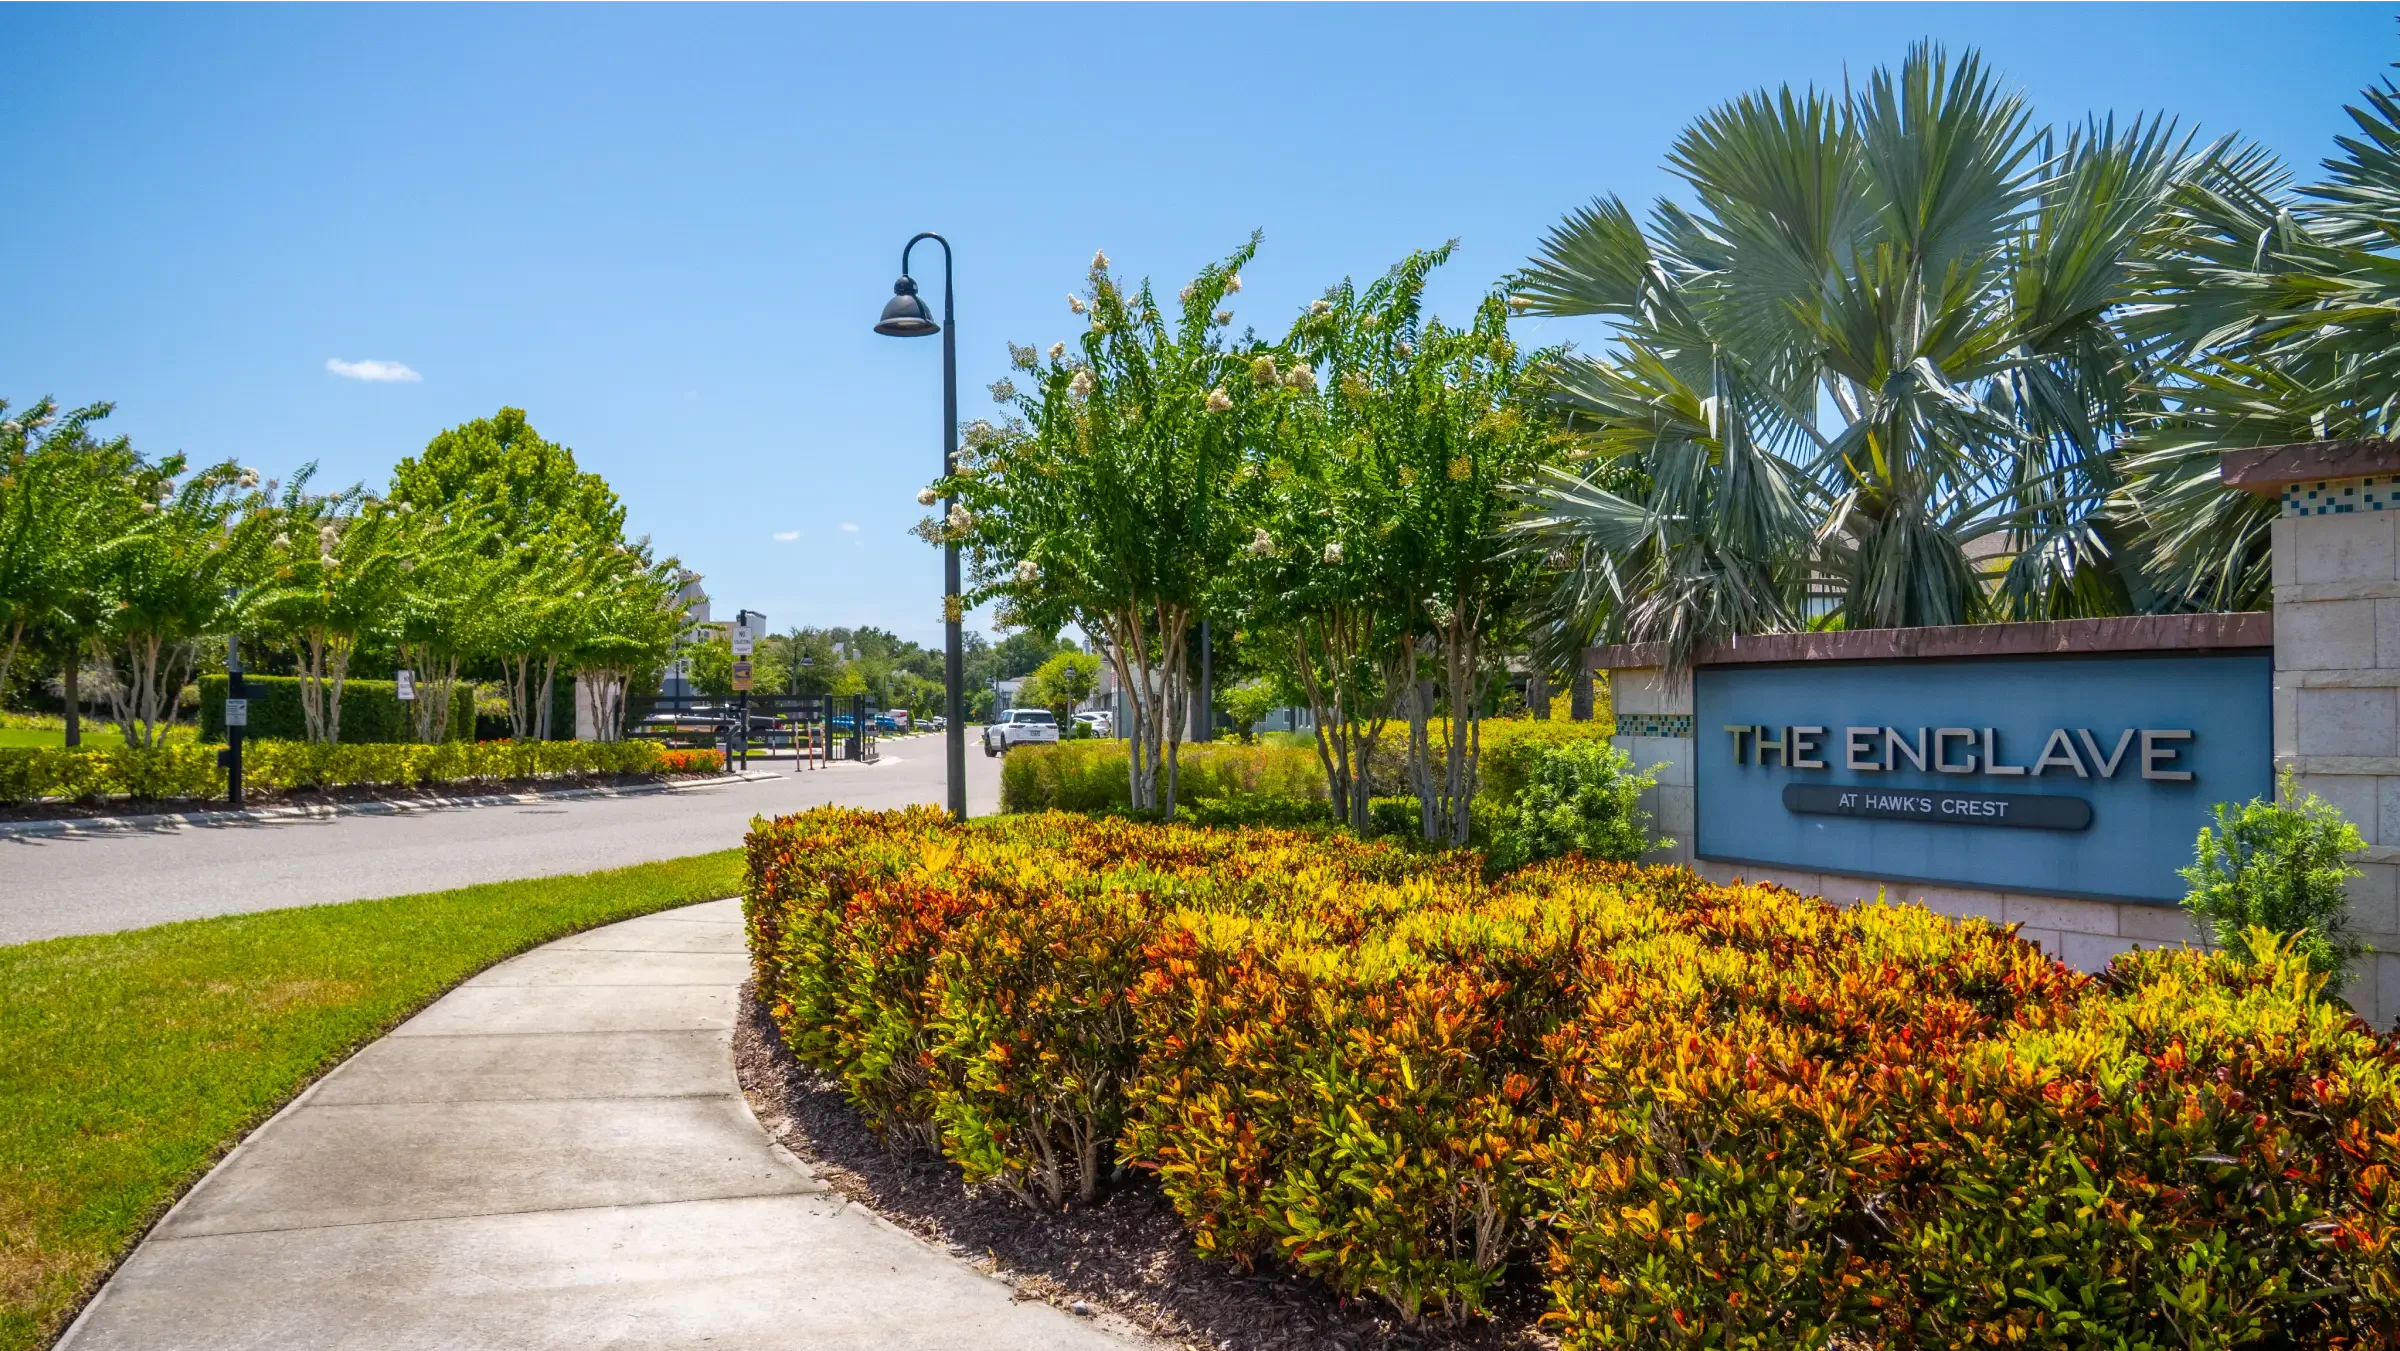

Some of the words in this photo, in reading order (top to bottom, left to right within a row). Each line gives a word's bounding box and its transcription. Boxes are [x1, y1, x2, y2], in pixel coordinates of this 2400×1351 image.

[1723, 725, 1823, 768] THE
[1846, 726, 2192, 781] ENCLAVE
[1838, 793, 1858, 808] AT
[1865, 795, 1932, 813] HAWK'S
[1941, 799, 2009, 817] CREST
